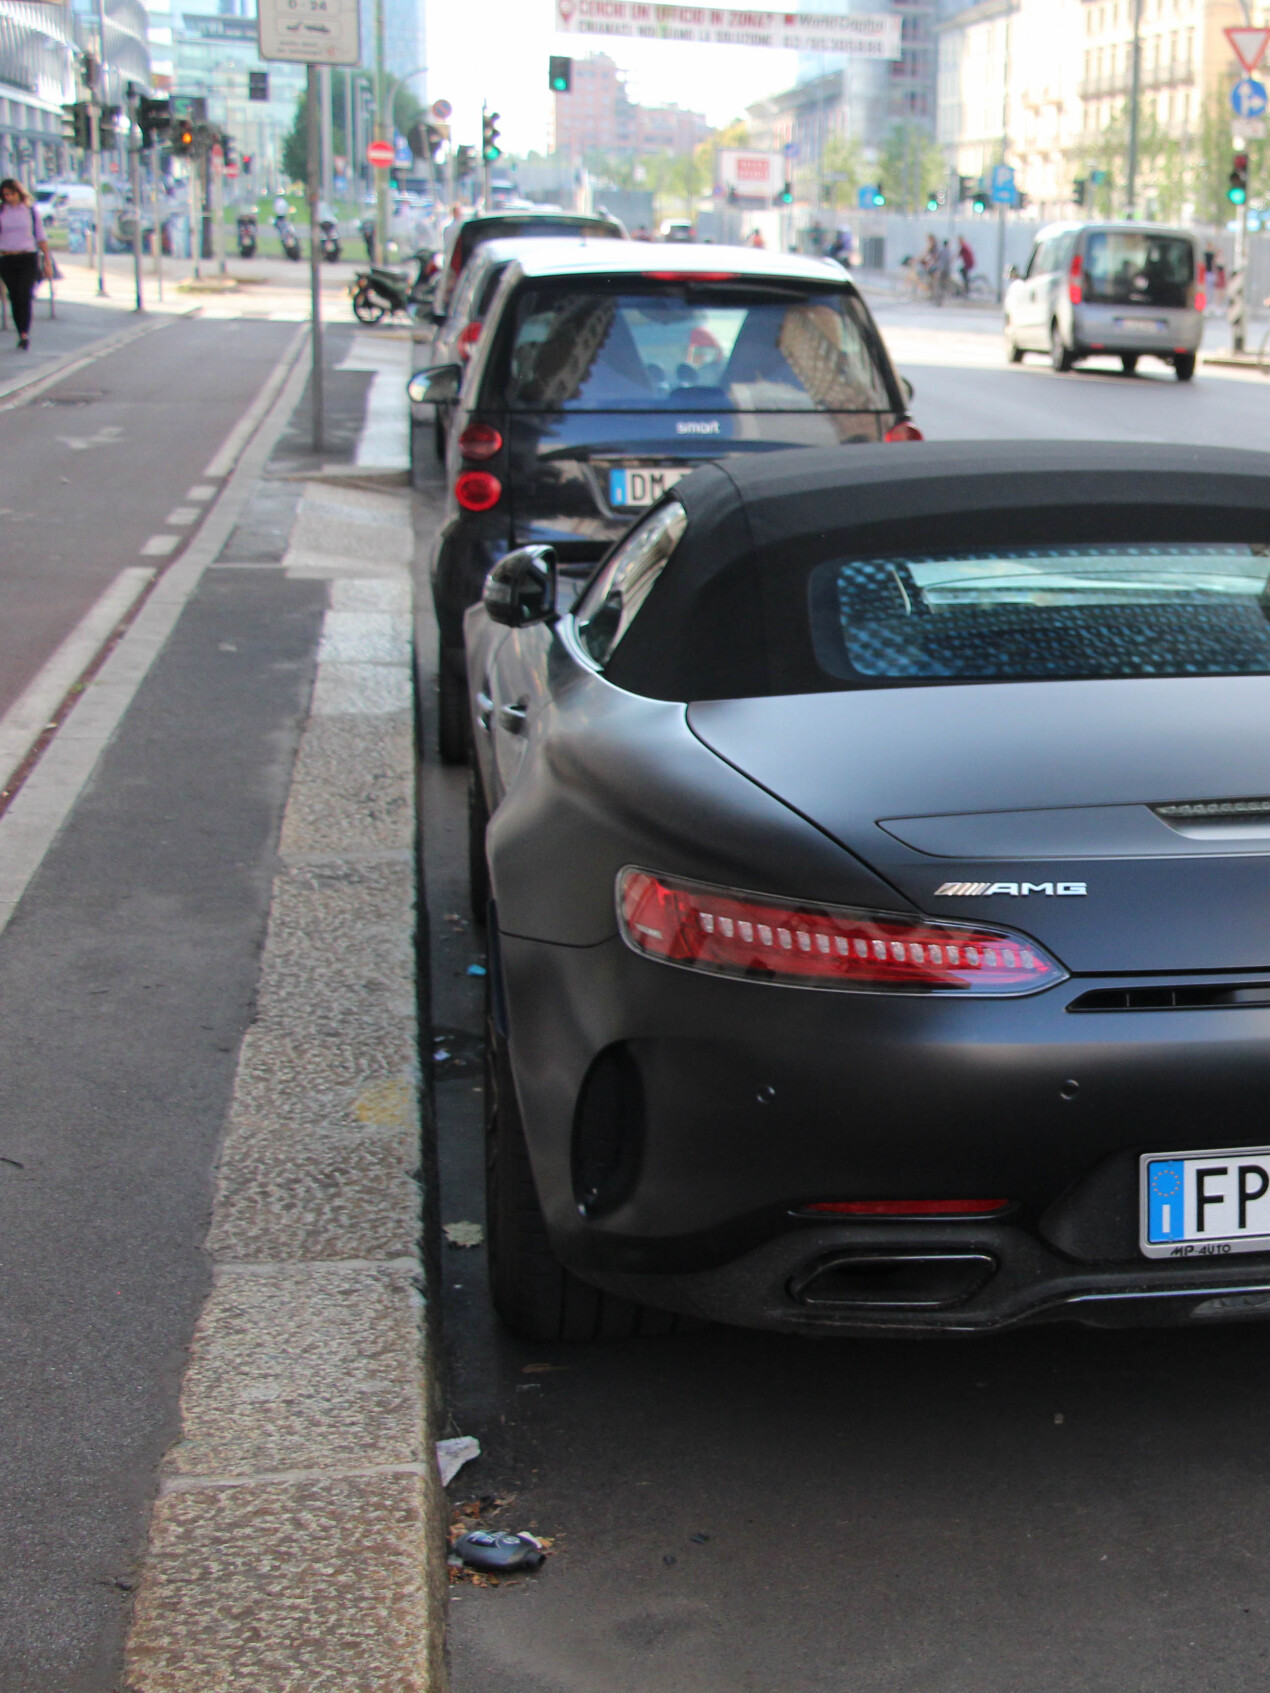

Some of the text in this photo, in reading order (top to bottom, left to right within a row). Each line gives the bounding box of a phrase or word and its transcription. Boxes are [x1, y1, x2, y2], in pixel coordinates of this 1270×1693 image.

[676, 421, 719, 434] smart
[982, 882, 1088, 896] AMG
[1196, 1165, 1270, 1232] FP
